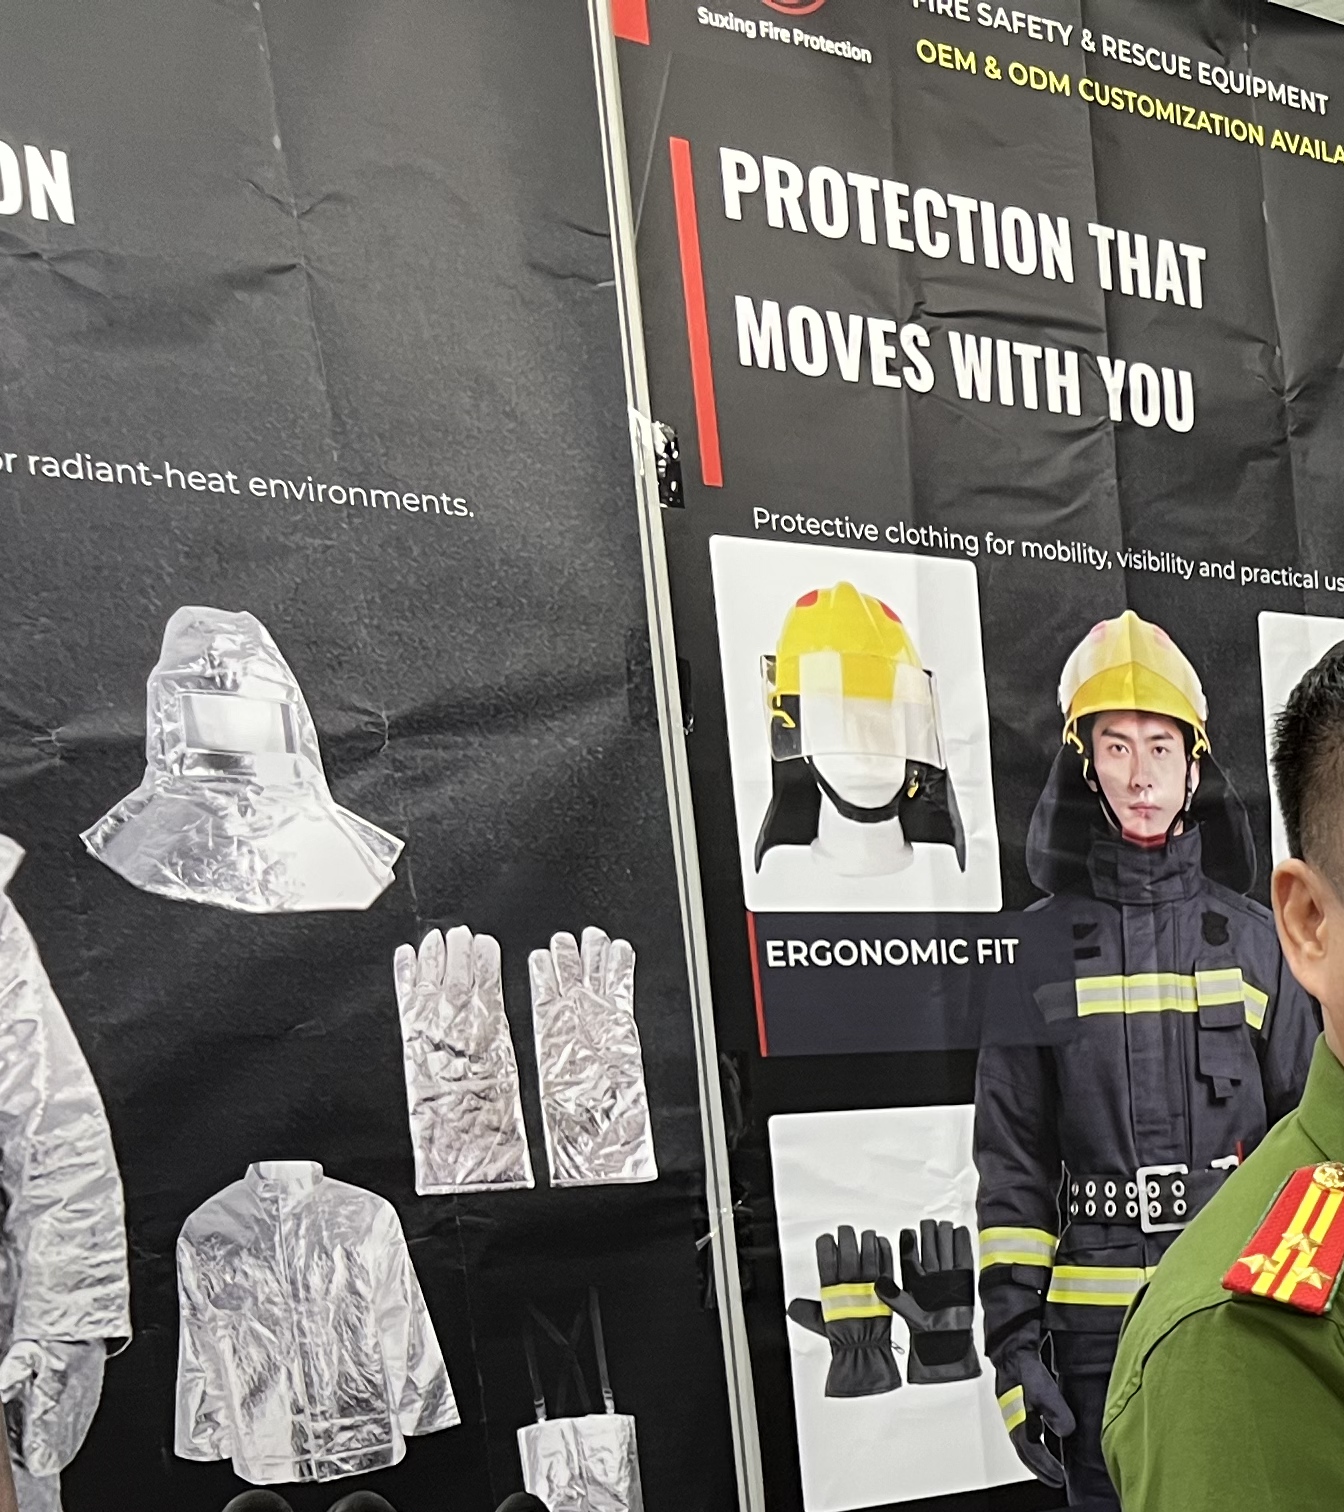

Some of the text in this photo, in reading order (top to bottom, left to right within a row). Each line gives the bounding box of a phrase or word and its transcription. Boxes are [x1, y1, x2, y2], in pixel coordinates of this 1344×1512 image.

[698, 6, 871, 63] Suxing Fire Protection
[977, 3, 1073, 45] SAFETY
[1081, 29, 1096, 52] &
[1102, 34, 1191, 79] RESCUE
[1198, 62, 1328, 114] EQUIPMENT
[917, 39, 976, 74] OEM
[985, 56, 1001, 79] &
[1009, 62, 1070, 96] ODM
[1079, 78, 1263, 146] CUSTOMIZATION
[720, 147, 1206, 308] PROTECTION THAT
[735, 295, 1194, 432] MOVES WITH YOU
[28, 453, 240, 494] radiant-heat
[249, 476, 474, 517] environments.
[754, 507, 878, 541] Protective
[886, 522, 978, 556] clothing
[985, 532, 1015, 555] for
[1022, 540, 1111, 570] mobility,
[1117, 548, 1194, 579] visibility
[1199, 560, 1235, 579] and
[1241, 567, 1318, 589] practical
[767, 939, 1018, 967] ERGONOMIC FIT
